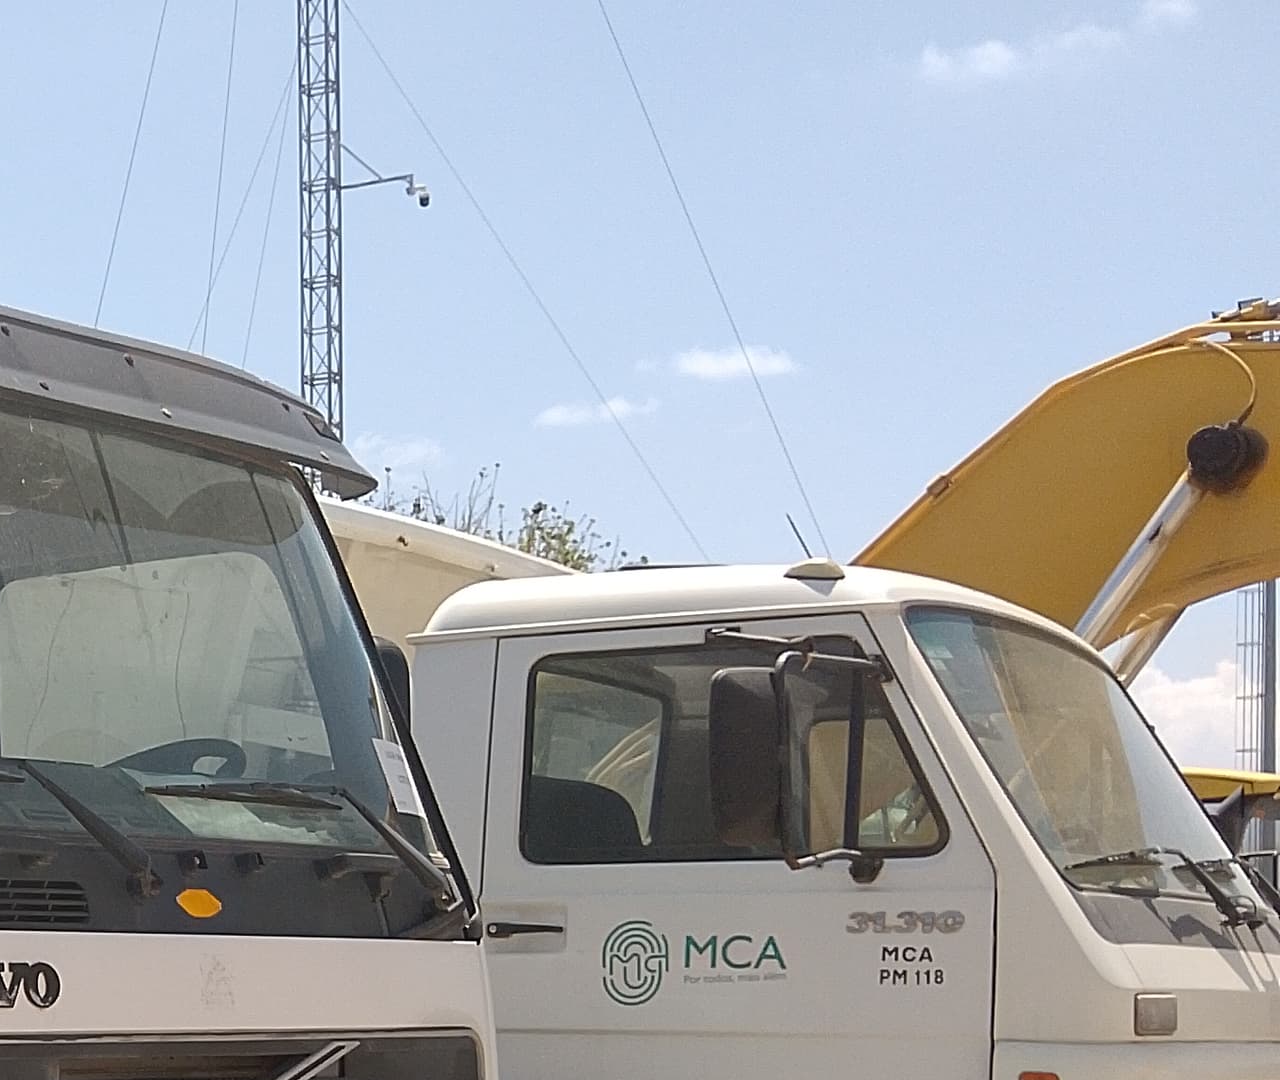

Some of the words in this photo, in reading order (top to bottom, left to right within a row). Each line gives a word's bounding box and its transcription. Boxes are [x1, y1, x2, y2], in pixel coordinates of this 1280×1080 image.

[684, 935, 787, 970] MCA
[881, 946, 934, 963] MCA
[879, 968, 908, 985] PM
[914, 968, 944, 985] 118
